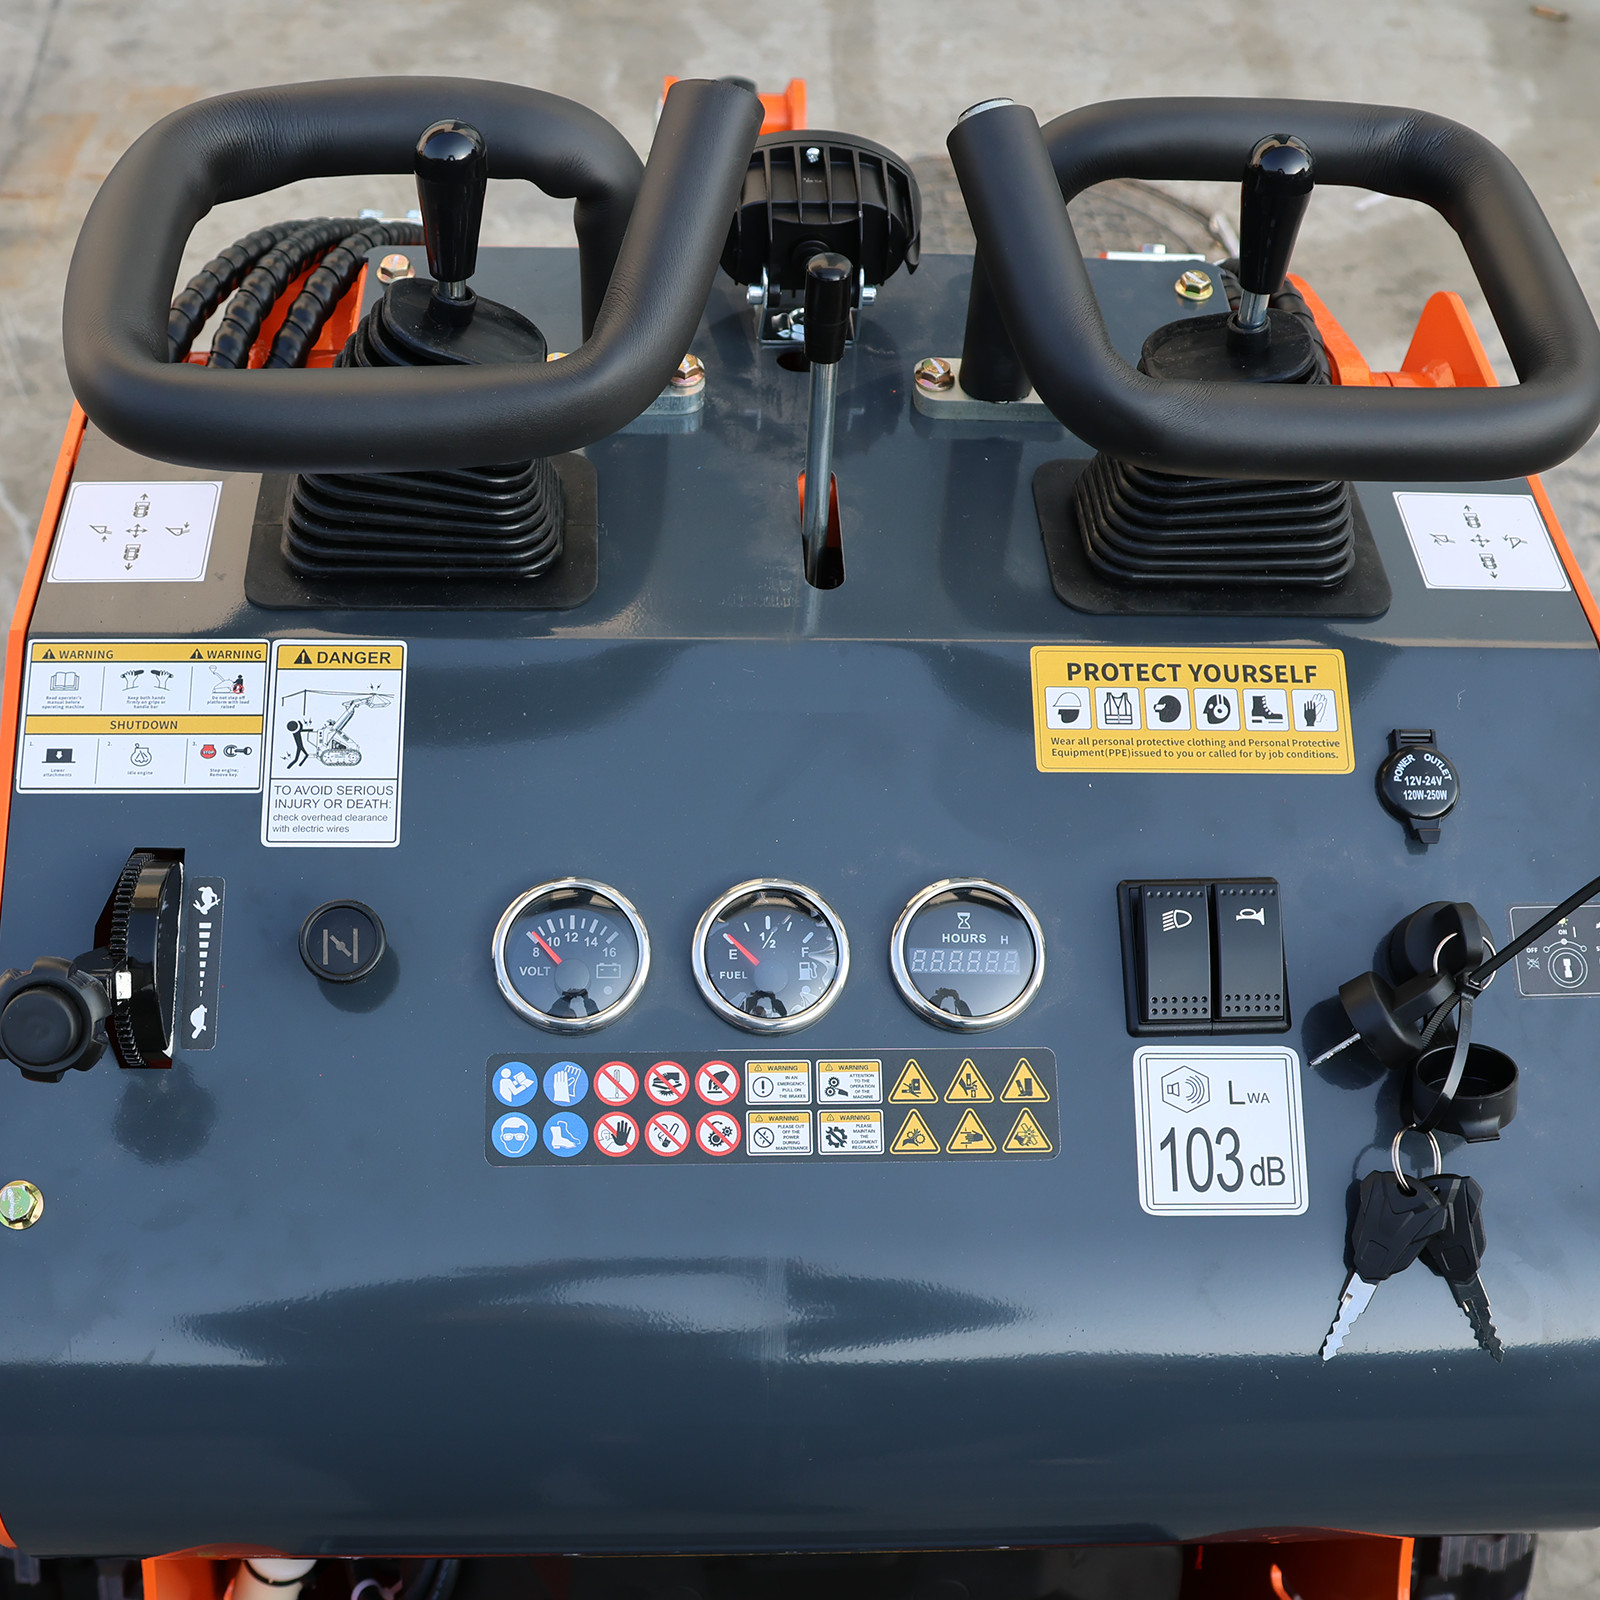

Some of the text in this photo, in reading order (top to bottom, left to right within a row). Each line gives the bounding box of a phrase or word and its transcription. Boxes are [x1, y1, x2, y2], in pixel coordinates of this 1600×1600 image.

[58, 650, 114, 660] WARNING
[207, 649, 262, 659] WARNING
[317, 652, 391, 664] DANGER
[1067, 662, 1317, 683] PROTECT YOURSELF
[110, 720, 178, 730] SHUTDOWN
[1051, 737, 1340, 748] Wear all personal protective clothing and Personal Protective
[1164, 749, 1174, 757] to
[1176, 751, 1194, 759] you
[1209, 749, 1237, 758] called
[1240, 749, 1253, 758] for
[1255, 749, 1266, 759] by
[1268, 749, 1284, 760] job
[1286, 750, 1338, 759] conditions.
[1393, 753, 1452, 782] POWER OUTLET
[1404, 776, 1442, 786] 12V-24V
[274, 785, 394, 796] TO AVOID SERIOUS
[1403, 790, 1448, 800] 120W-250W
[274, 799, 392, 809] INJURY OR DEATH:
[272, 813, 388, 821] check overhead clearance
[272, 825, 350, 833] with electric wires
[547, 937, 561, 947] 10
[565, 932, 579, 942] 12
[584, 937, 598, 947] 14
[942, 933, 1009, 945] HOURS H
[532, 947, 540, 957] 8
[602, 948, 617, 957] 16
[728, 949, 738, 960] E
[801, 947, 810, 958] F
[520, 966, 551, 976] VOLT
[720, 971, 748, 980] FUEL
[1160, 1126, 1286, 1193] 103 dB
